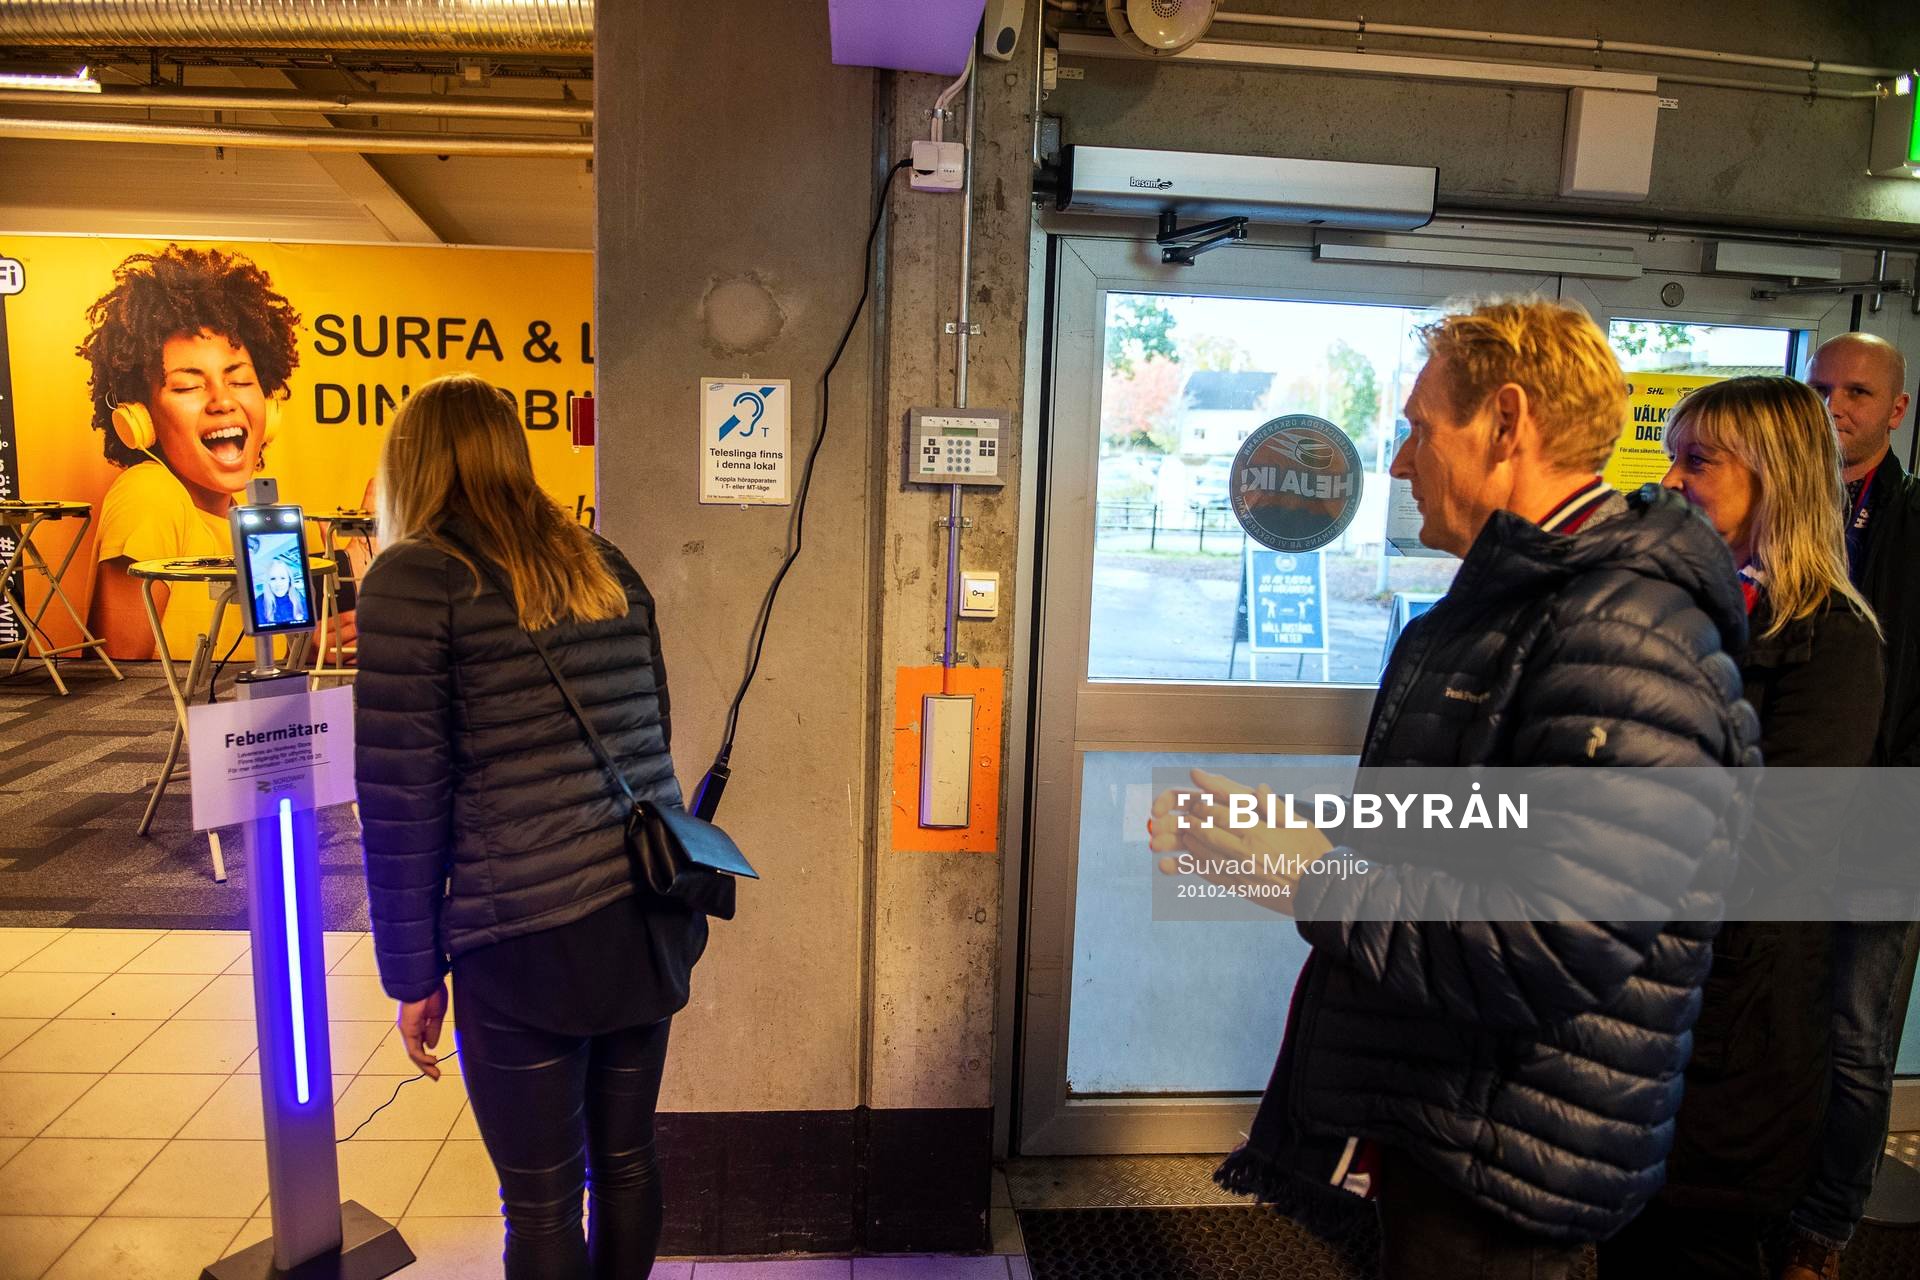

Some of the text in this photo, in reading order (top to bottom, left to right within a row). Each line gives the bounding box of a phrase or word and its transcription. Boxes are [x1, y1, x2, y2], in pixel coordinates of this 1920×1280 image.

[1130, 176, 1158, 188] besam
[314, 314, 504, 361] SURFA
[522, 320, 562, 364] &
[1647, 387, 1664, 395] SHL
[1634, 404, 1671, 422] VÄLK
[762, 427, 769, 437] T
[710, 448, 783, 460] Teleslinga finns
[722, 461, 750, 469] denna
[754, 462, 776, 470] lokal
[225, 722, 328, 748] Febermätare
